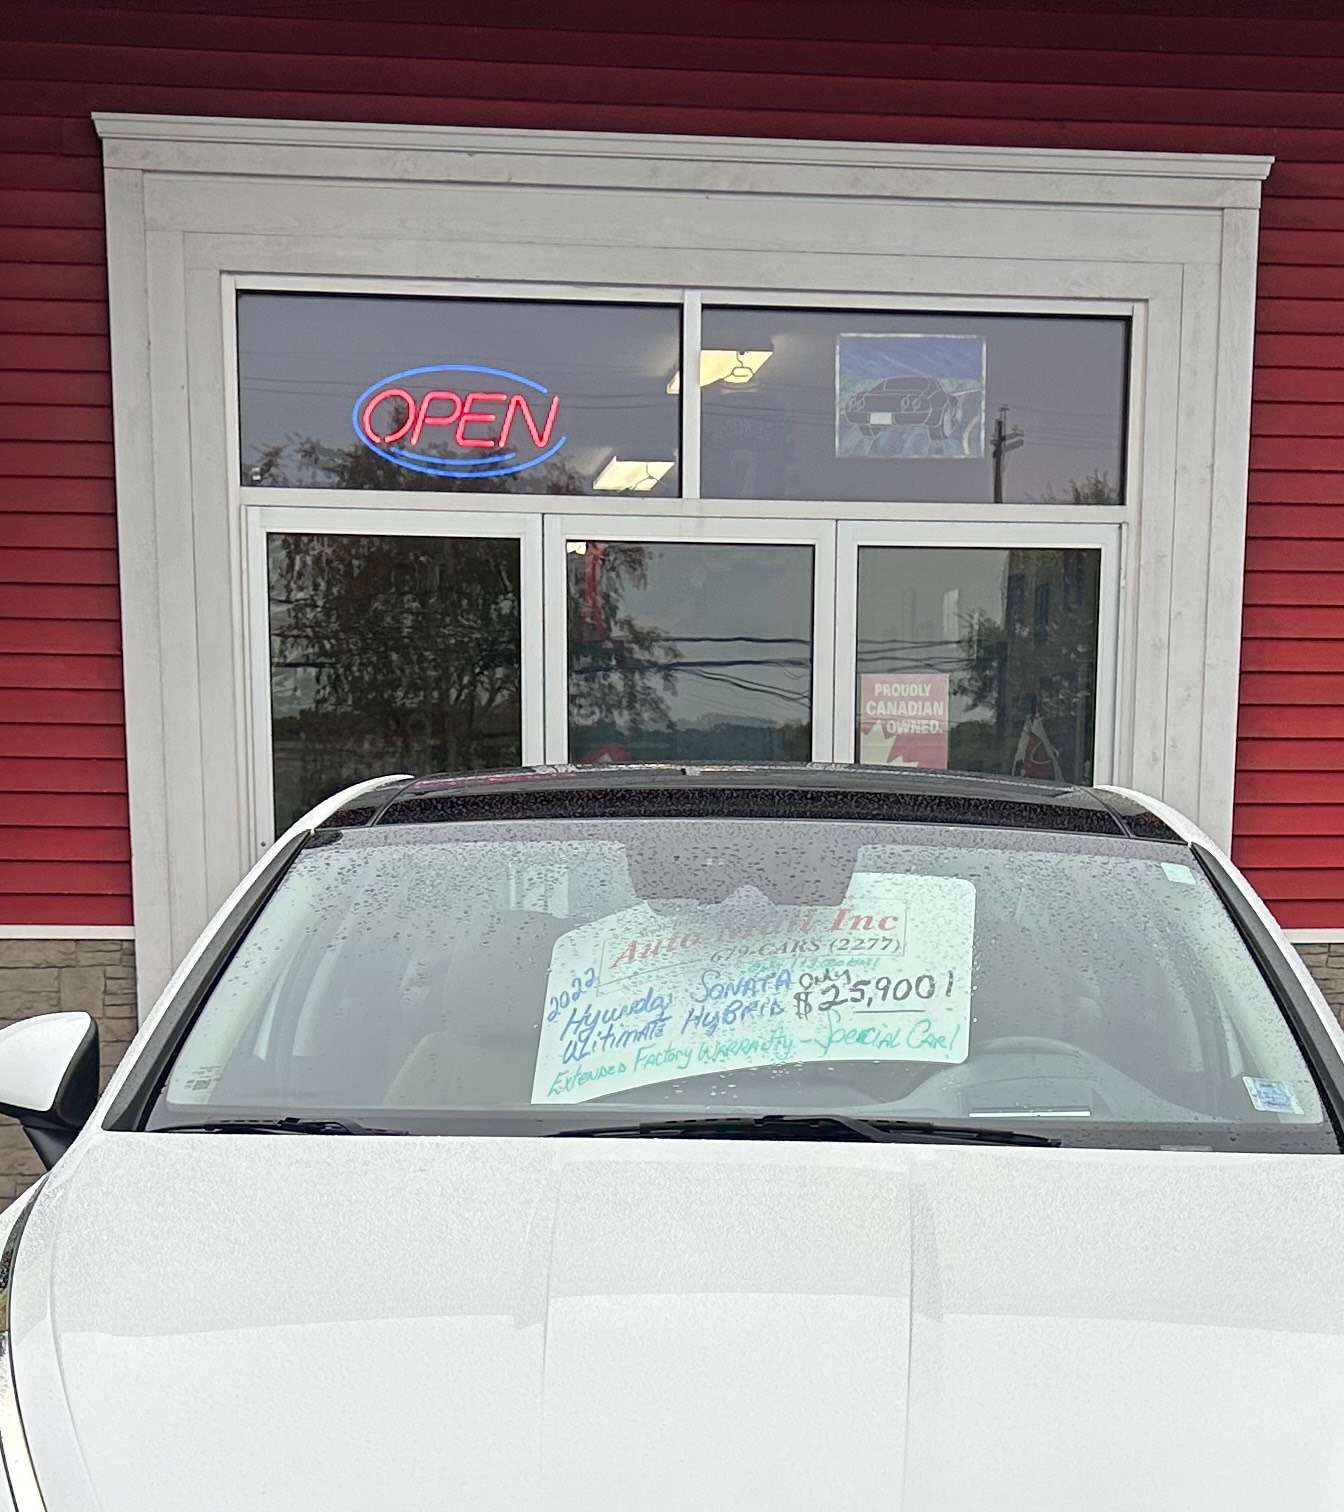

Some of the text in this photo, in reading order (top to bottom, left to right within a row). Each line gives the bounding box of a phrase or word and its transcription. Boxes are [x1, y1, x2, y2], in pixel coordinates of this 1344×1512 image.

[361, 387, 561, 449] OPEN
[874, 683, 932, 697] PROUDLY
[866, 700, 944, 716] CANADIAN
[826, 908, 899, 932] Inc
[829, 935, 901, 953] (2277)
[546, 967, 596, 1023] 2022
[690, 968, 792, 1004] SONATA
